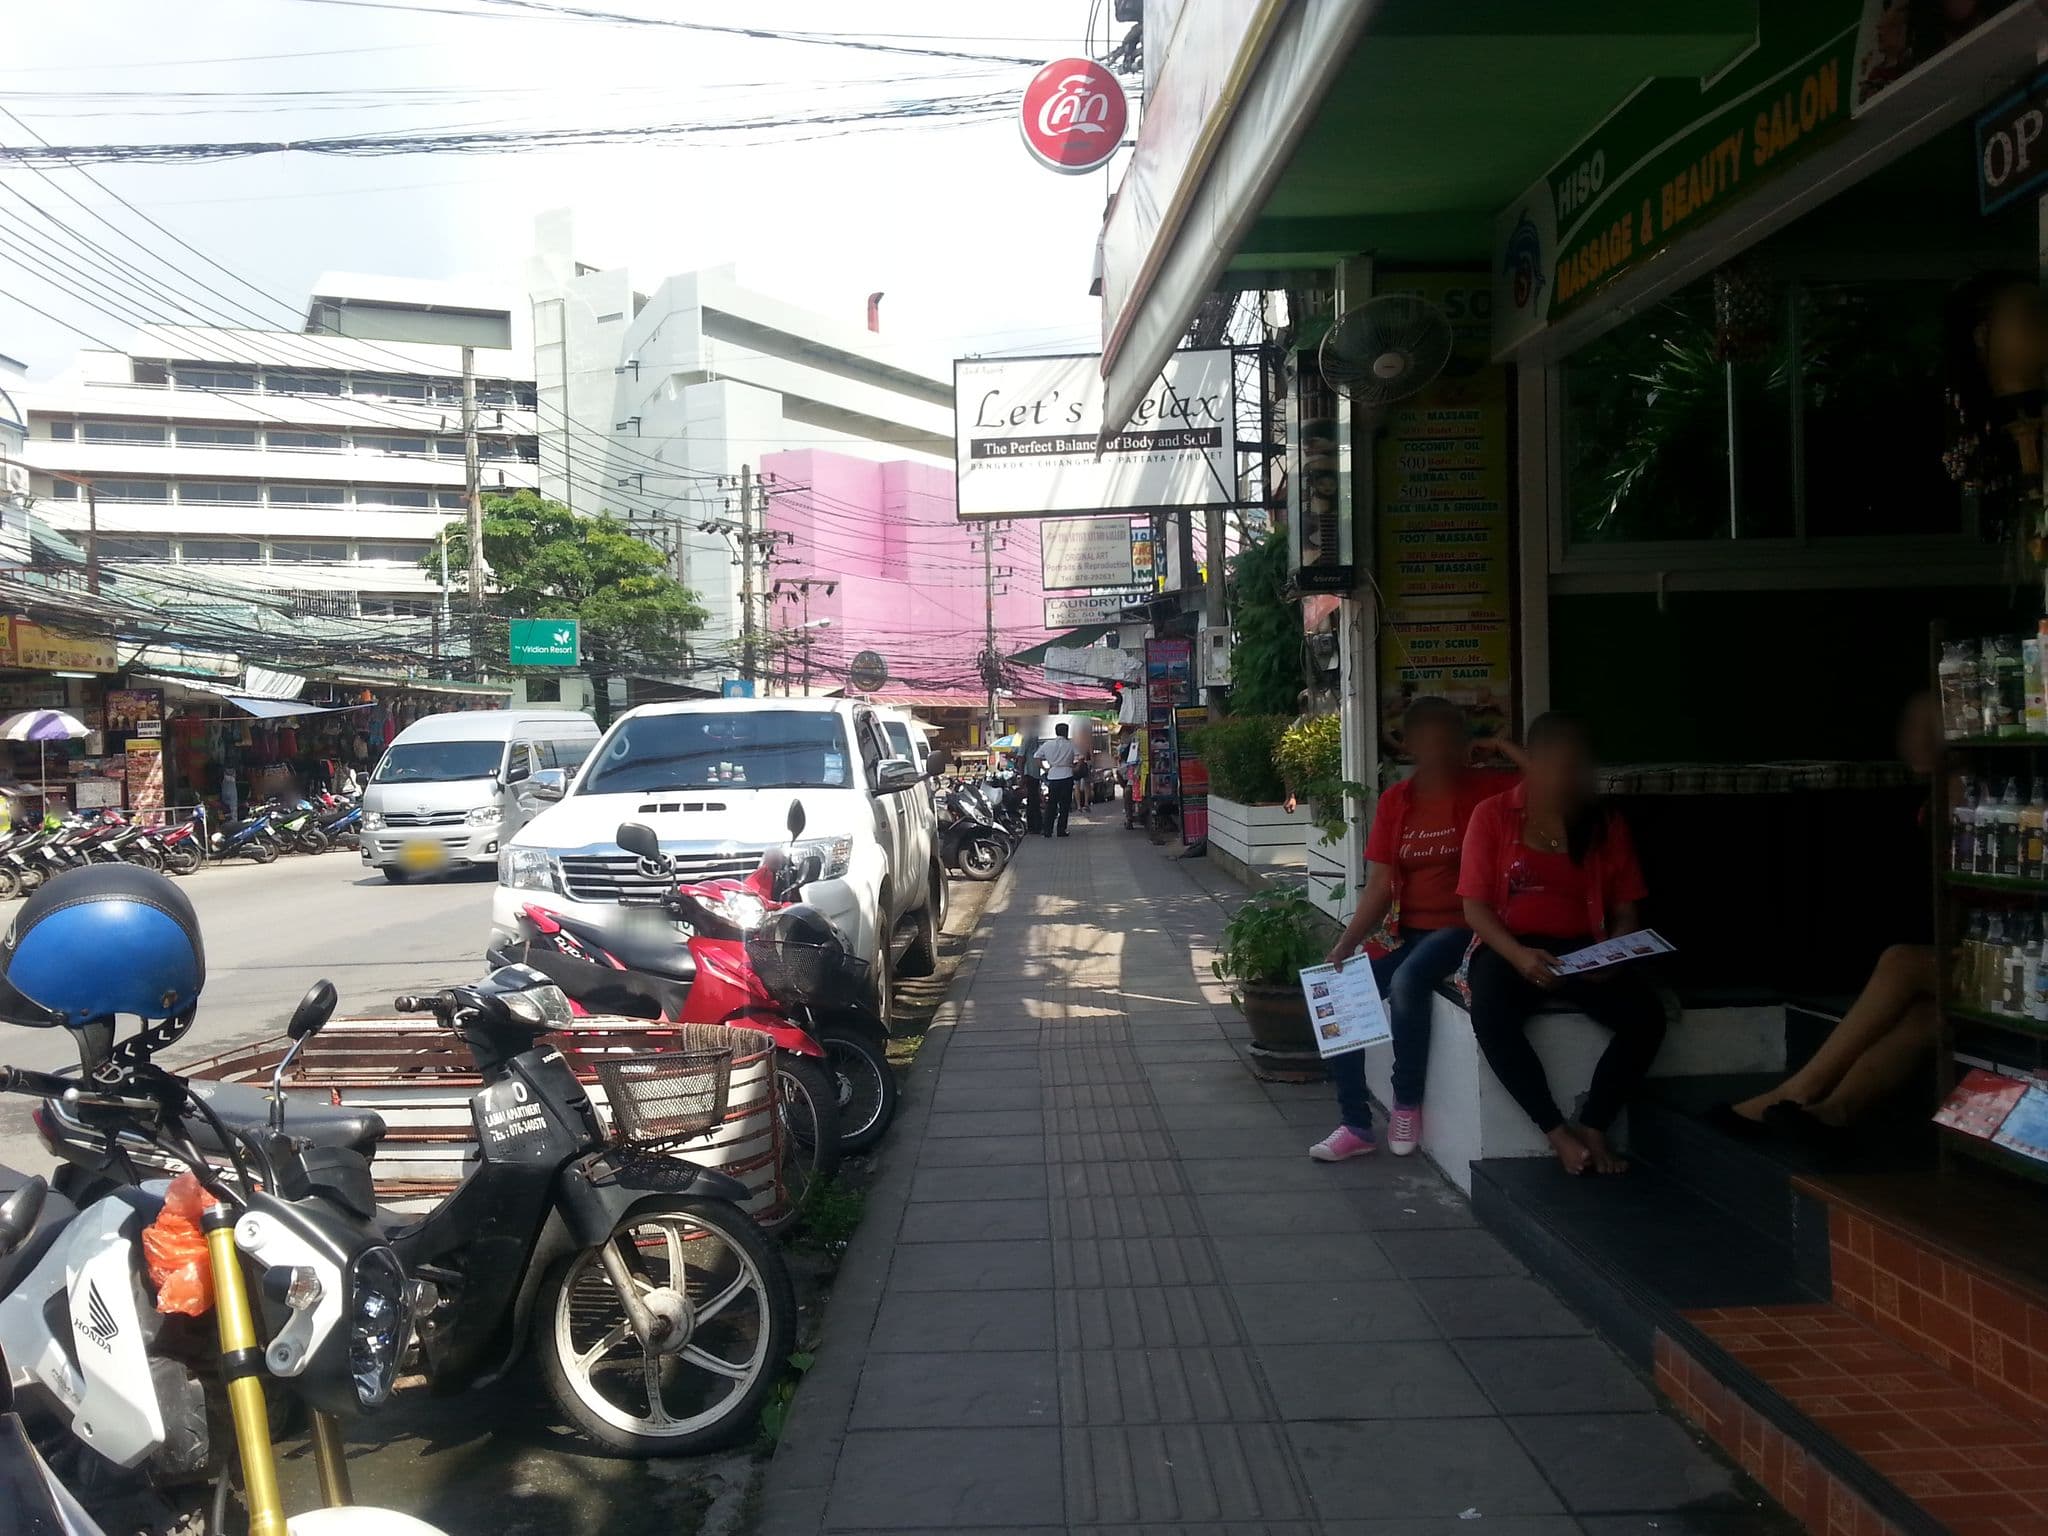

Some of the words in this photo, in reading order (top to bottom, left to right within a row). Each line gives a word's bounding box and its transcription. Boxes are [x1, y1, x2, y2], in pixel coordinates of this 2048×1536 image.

[1557, 212, 1632, 304] MASSAGE
[1640, 198, 1653, 245] &
[1662, 128, 1743, 232] BEAUTY
[1753, 60, 1838, 168] SALON
[1558, 149, 1605, 220] HISO
[973, 388, 1083, 428] Let's
[1129, 386, 1225, 426] elax
[984, 443, 1007, 455] The
[1010, 441, 1052, 454] Perfect
[1056, 439, 1097, 453] Balanc
[1123, 435, 1154, 451] Body
[1158, 434, 1180, 447] and
[1404, 441, 1456, 452] COCONUT
[1464, 441, 1480, 450] OIL
[1119, 454, 1167, 464] PATTAYA
[1179, 451, 1222, 461] PHUET
[1399, 533, 1425, 544] FOOT
[1436, 532, 1488, 543] MASSAGE
[1096, 551, 1109, 560] ART
[1084, 560, 1130, 571] Reproduction
[1401, 564, 1425, 574] THAI
[1435, 562, 1488, 573] MASSAGE
[1050, 597, 1117, 610] LAUNDRY
[522, 645, 549, 654] Viridian
[550, 645, 573, 654] Resort
[1410, 639, 1440, 649] BODY
[1444, 638, 1479, 649] SCRUB
[1402, 670, 1442, 681] BEAUTY
[1452, 668, 1488, 679] SALON
[1413, 845, 1434, 857] not
[511, 1081, 528, 1103] 0
[506, 1102, 542, 1121] APARTMENT
[73, 1317, 113, 1355] HONDA
